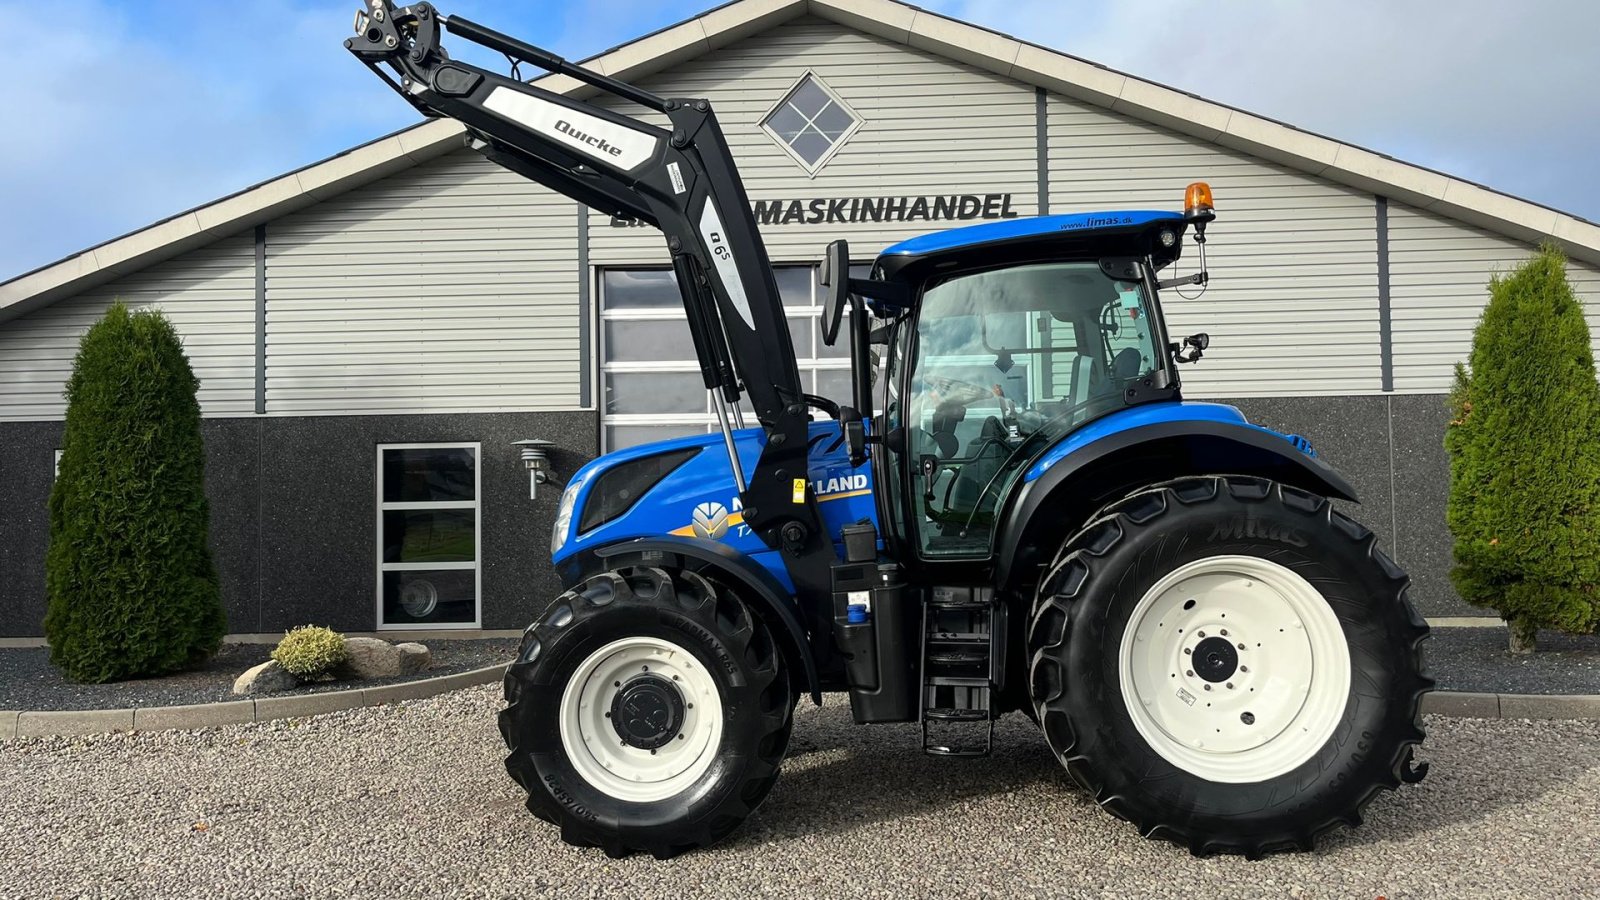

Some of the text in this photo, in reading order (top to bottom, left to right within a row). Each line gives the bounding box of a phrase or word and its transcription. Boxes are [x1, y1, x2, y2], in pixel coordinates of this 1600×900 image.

[554, 119, 623, 157] Quicke
[753, 193, 1018, 225] MASKINHANDEL
[1060, 217, 1133, 230] www.limas.dk
